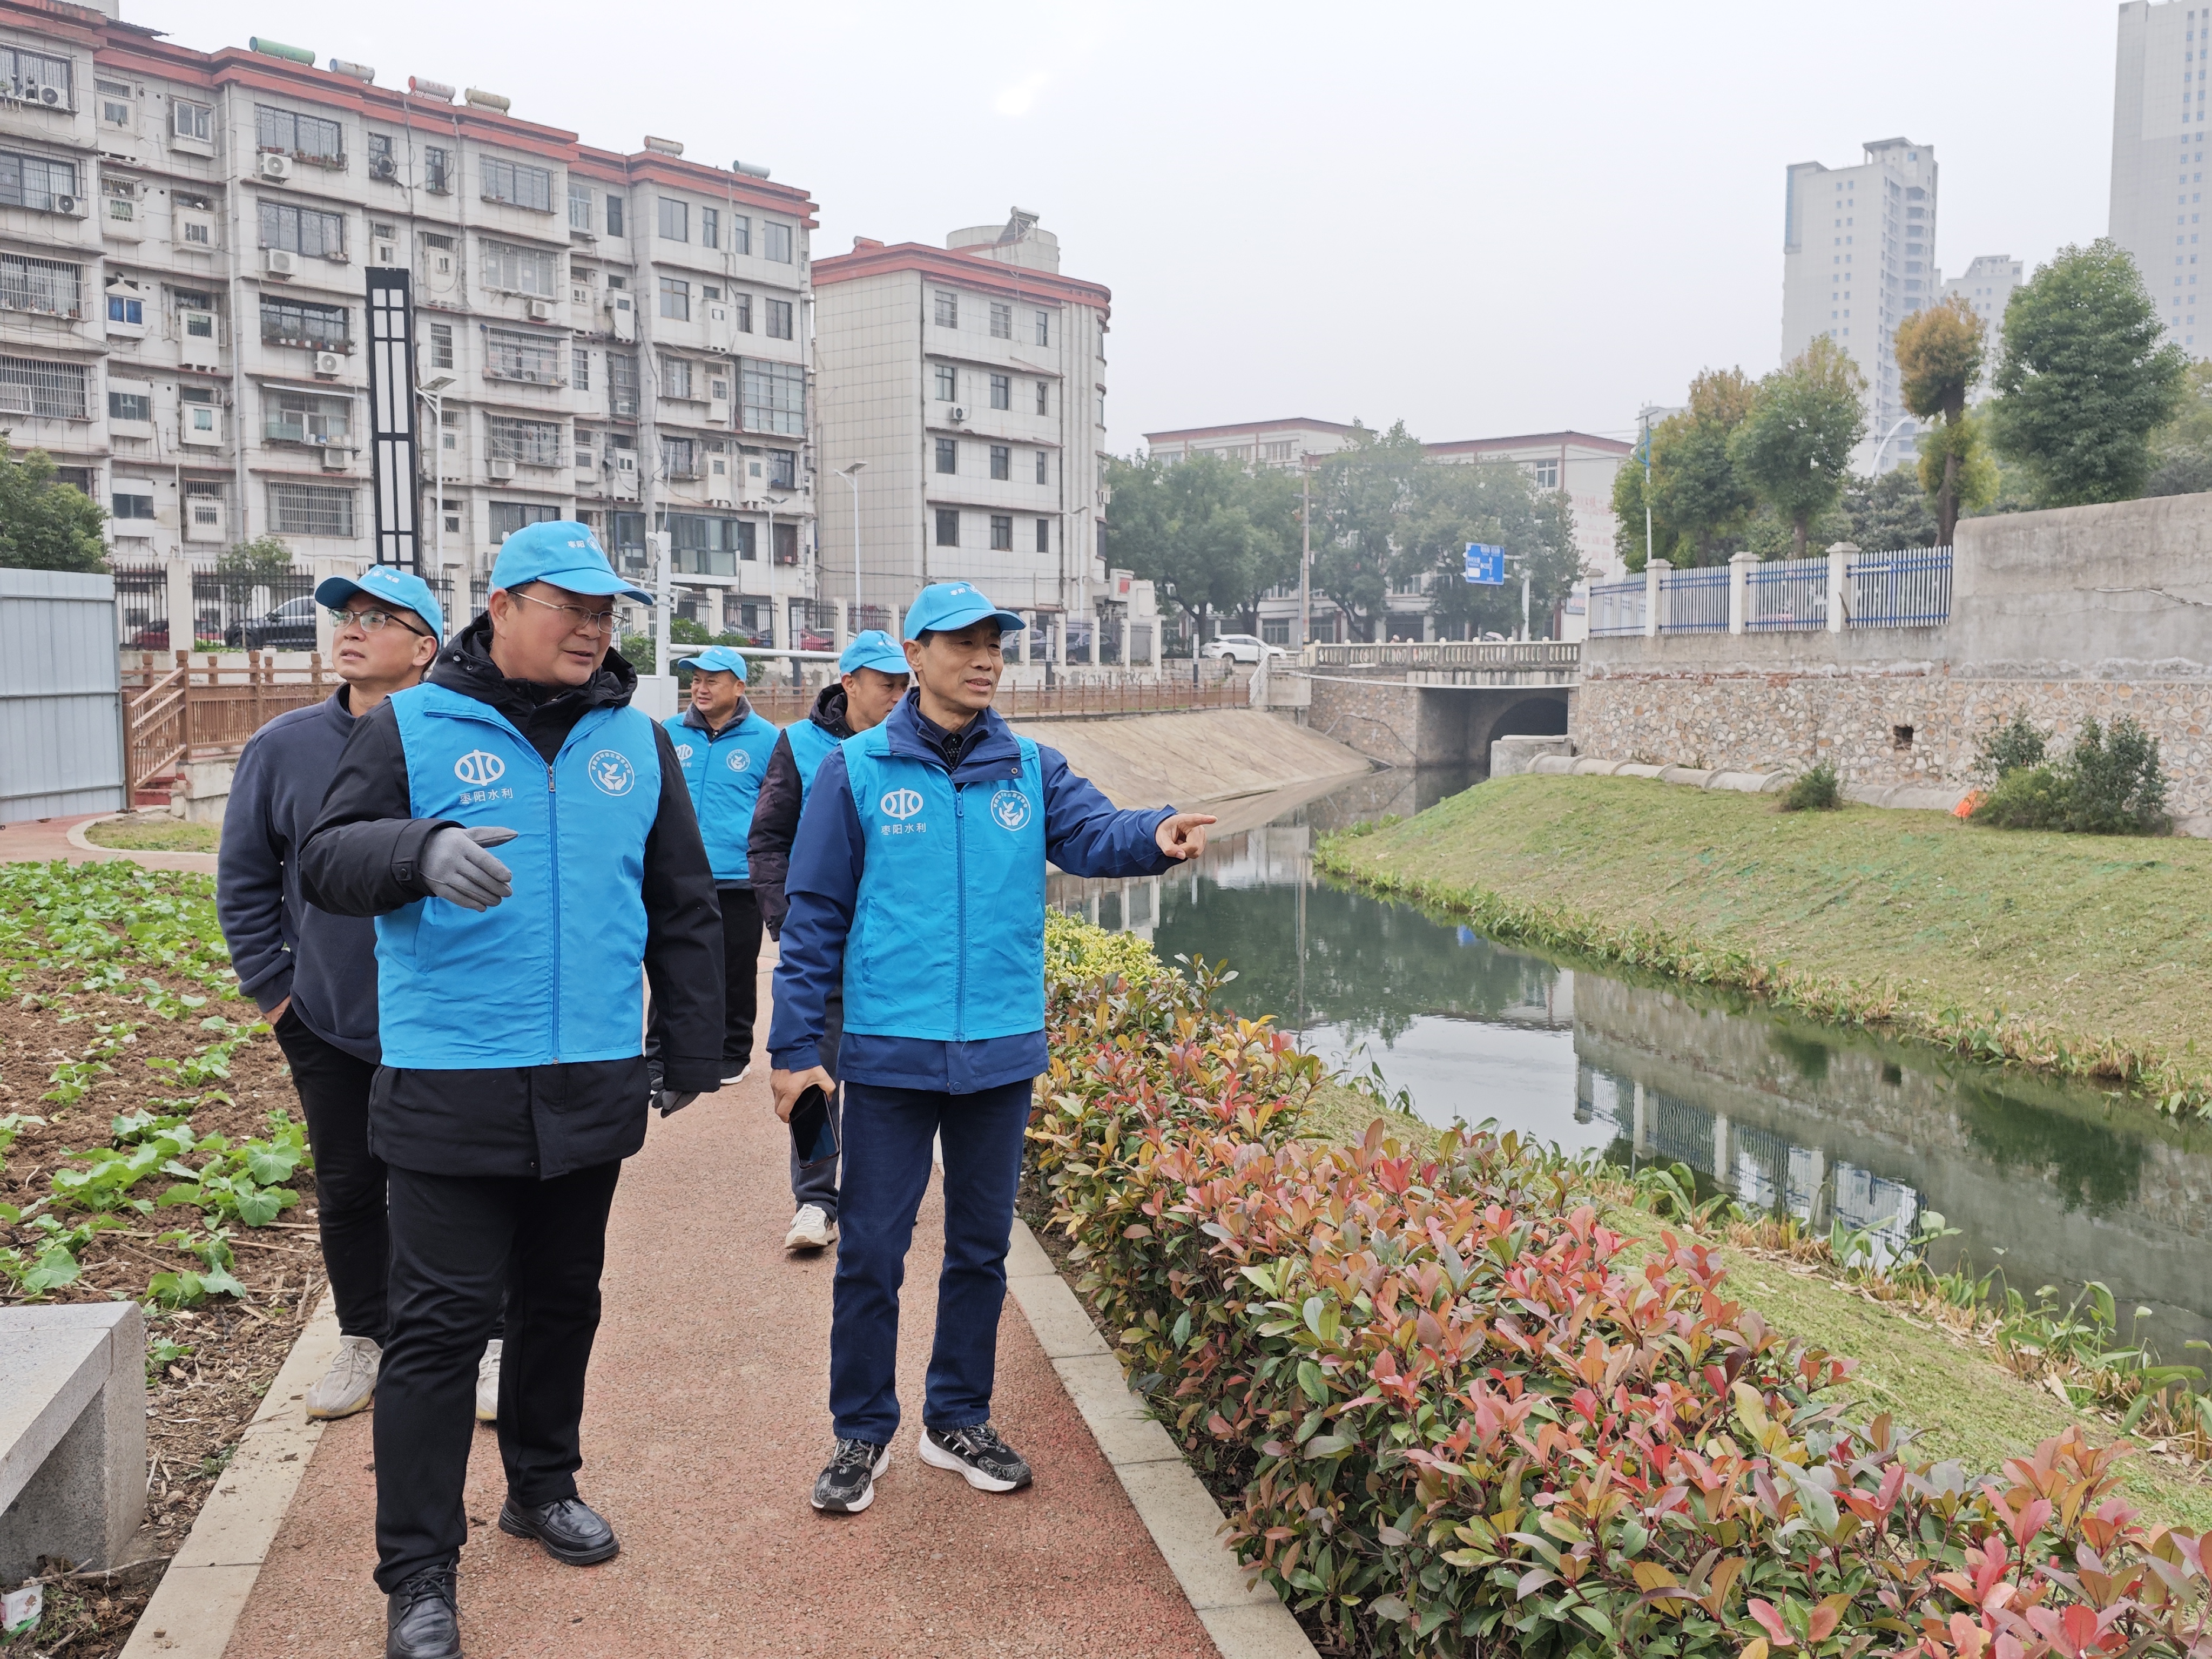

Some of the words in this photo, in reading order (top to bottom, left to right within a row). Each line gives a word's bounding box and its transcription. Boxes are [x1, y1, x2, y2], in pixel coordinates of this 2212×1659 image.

[459, 787, 513, 805] 枣阳水利
[881, 822, 926, 835] 枣阳水利
